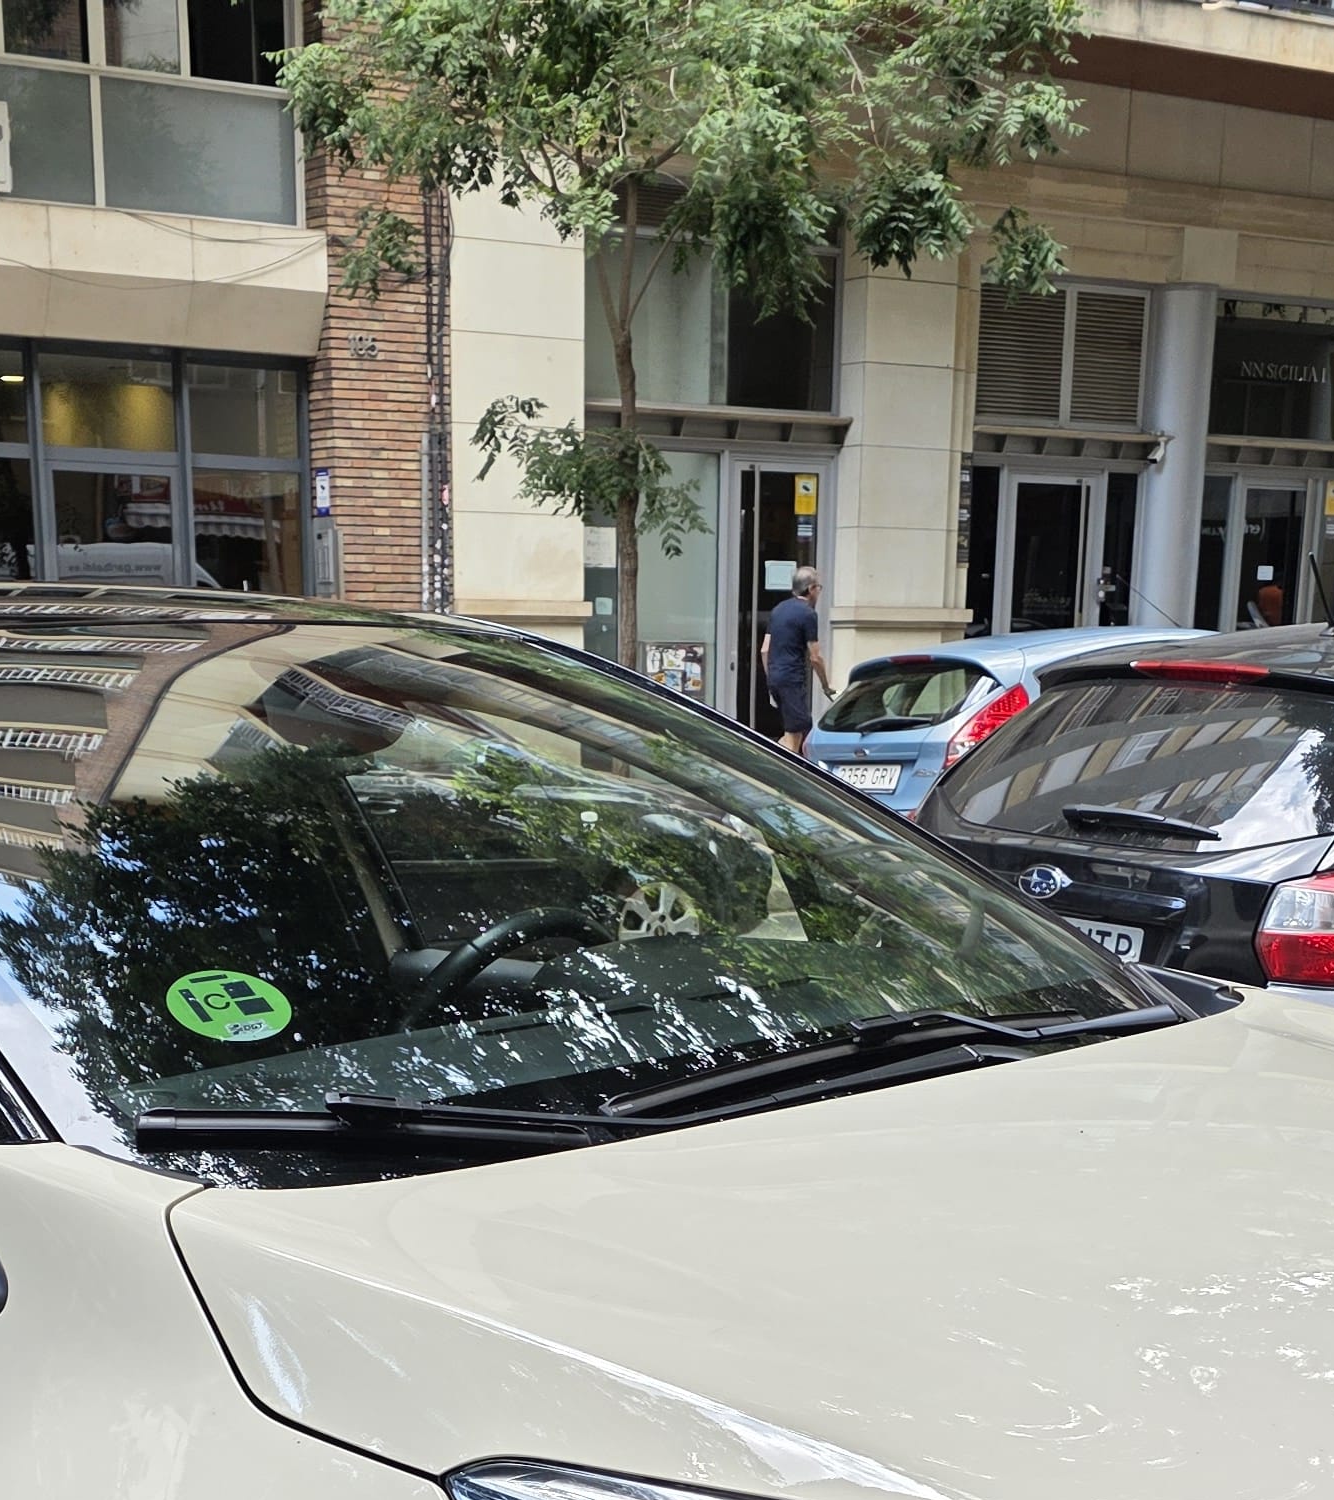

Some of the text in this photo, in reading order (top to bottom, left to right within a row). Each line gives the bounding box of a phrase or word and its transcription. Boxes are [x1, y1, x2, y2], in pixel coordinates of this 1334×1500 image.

[871, 767, 897, 785] GRV
[203, 993, 231, 1010] C
[243, 1021, 264, 1032] DGT
